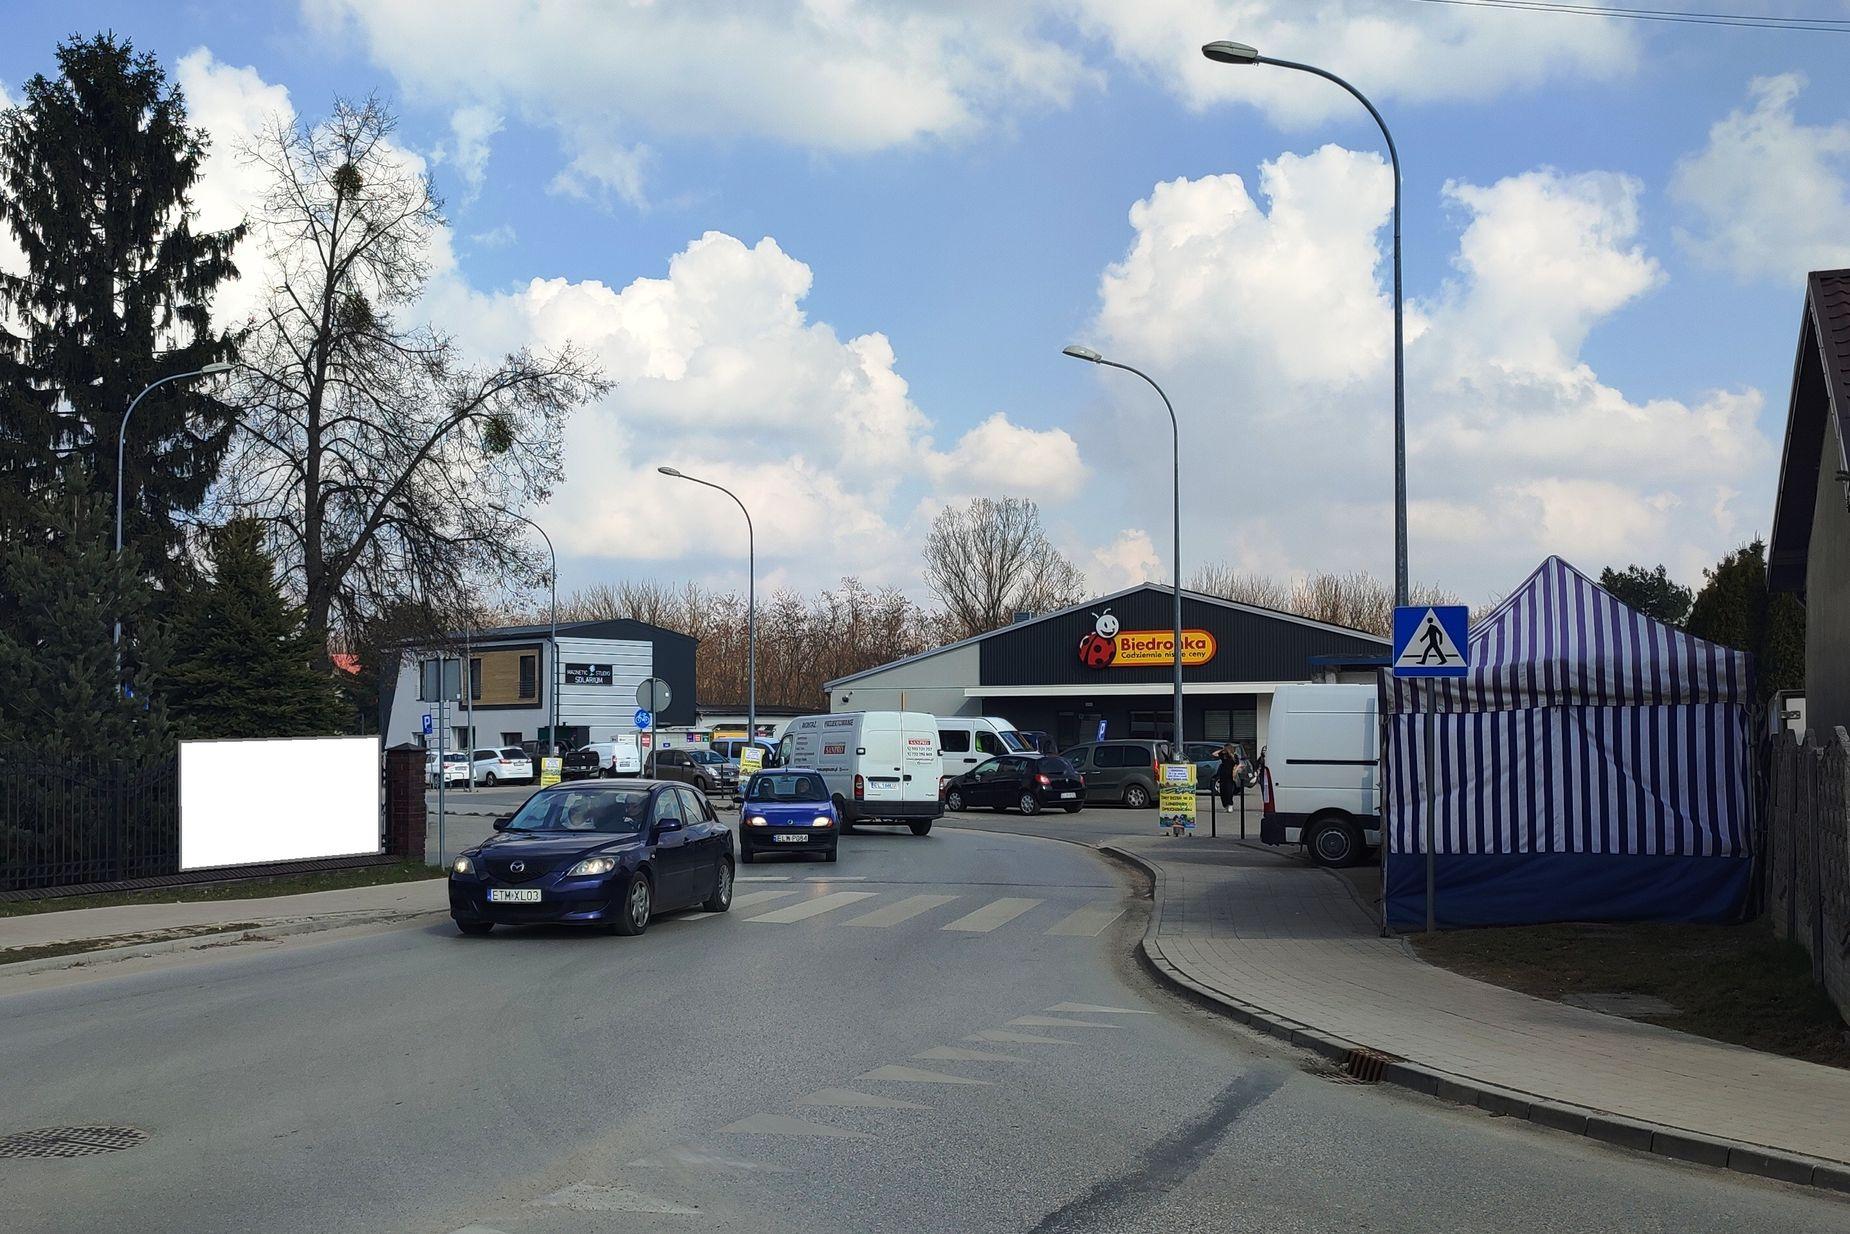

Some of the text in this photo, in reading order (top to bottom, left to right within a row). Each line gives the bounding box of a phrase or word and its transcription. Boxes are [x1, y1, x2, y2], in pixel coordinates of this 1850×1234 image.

[575, 675, 603, 683] SOLARIUM
[492, 890, 539, 901] ETM XL03
